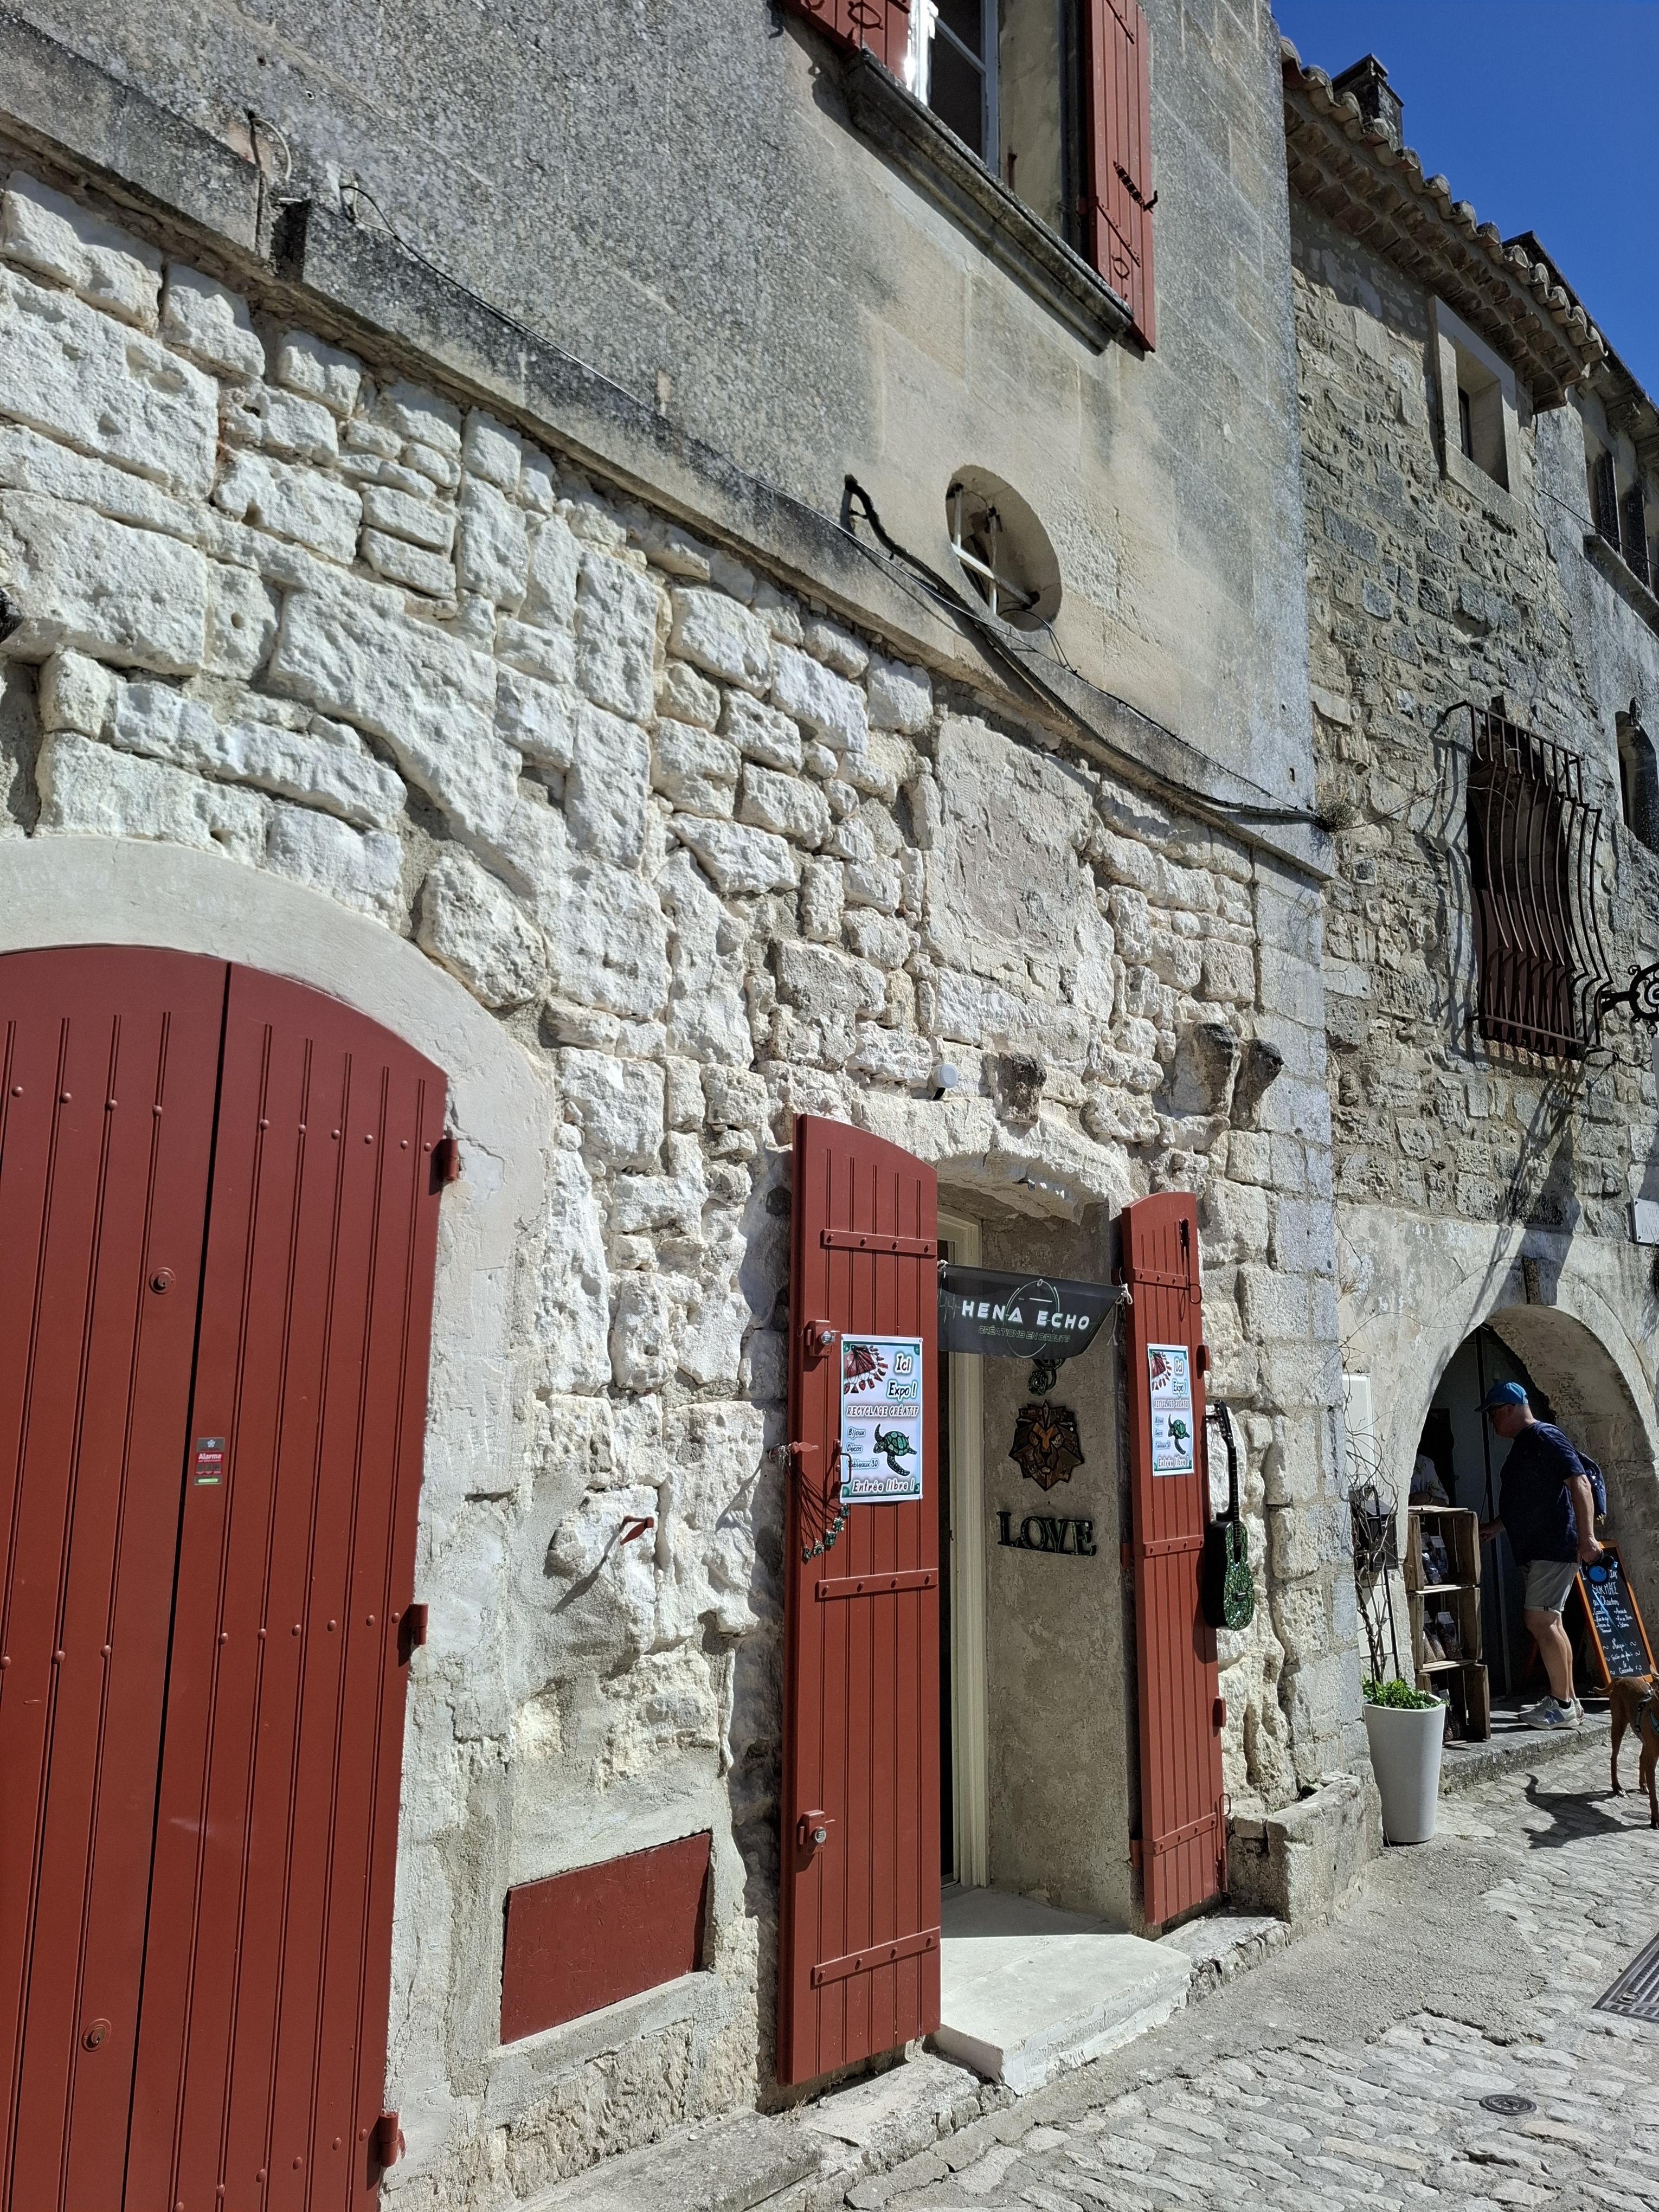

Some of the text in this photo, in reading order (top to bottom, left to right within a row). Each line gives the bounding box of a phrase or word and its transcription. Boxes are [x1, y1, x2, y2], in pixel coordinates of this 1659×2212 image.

[1648, 1207, 1659, 1218] RUE
[1641, 1223, 1649, 1234] LA
[962, 1300, 1090, 1330] HENA ECHO
[978, 1324, 1025, 1339] CRÉATIONS
[1025, 1332, 1038, 1340] EN
[896, 1355, 911, 1372] Ici
[888, 1381, 910, 1400] Expo
[1173, 1380, 1184, 1394] Expo
[846, 1404, 919, 1416] RECYCLAGE CRÉATIF
[1154, 1400, 1174, 1408] RECYCLAGE
[848, 1427, 866, 1438] Bijoux
[846, 1443, 863, 1452] Décos
[1158, 1457, 1174, 1468] Entrée
[853, 1480, 884, 1493] Entrée
[886, 1478, 908, 1491] libre
[996, 1510, 1097, 1557] LOVE
